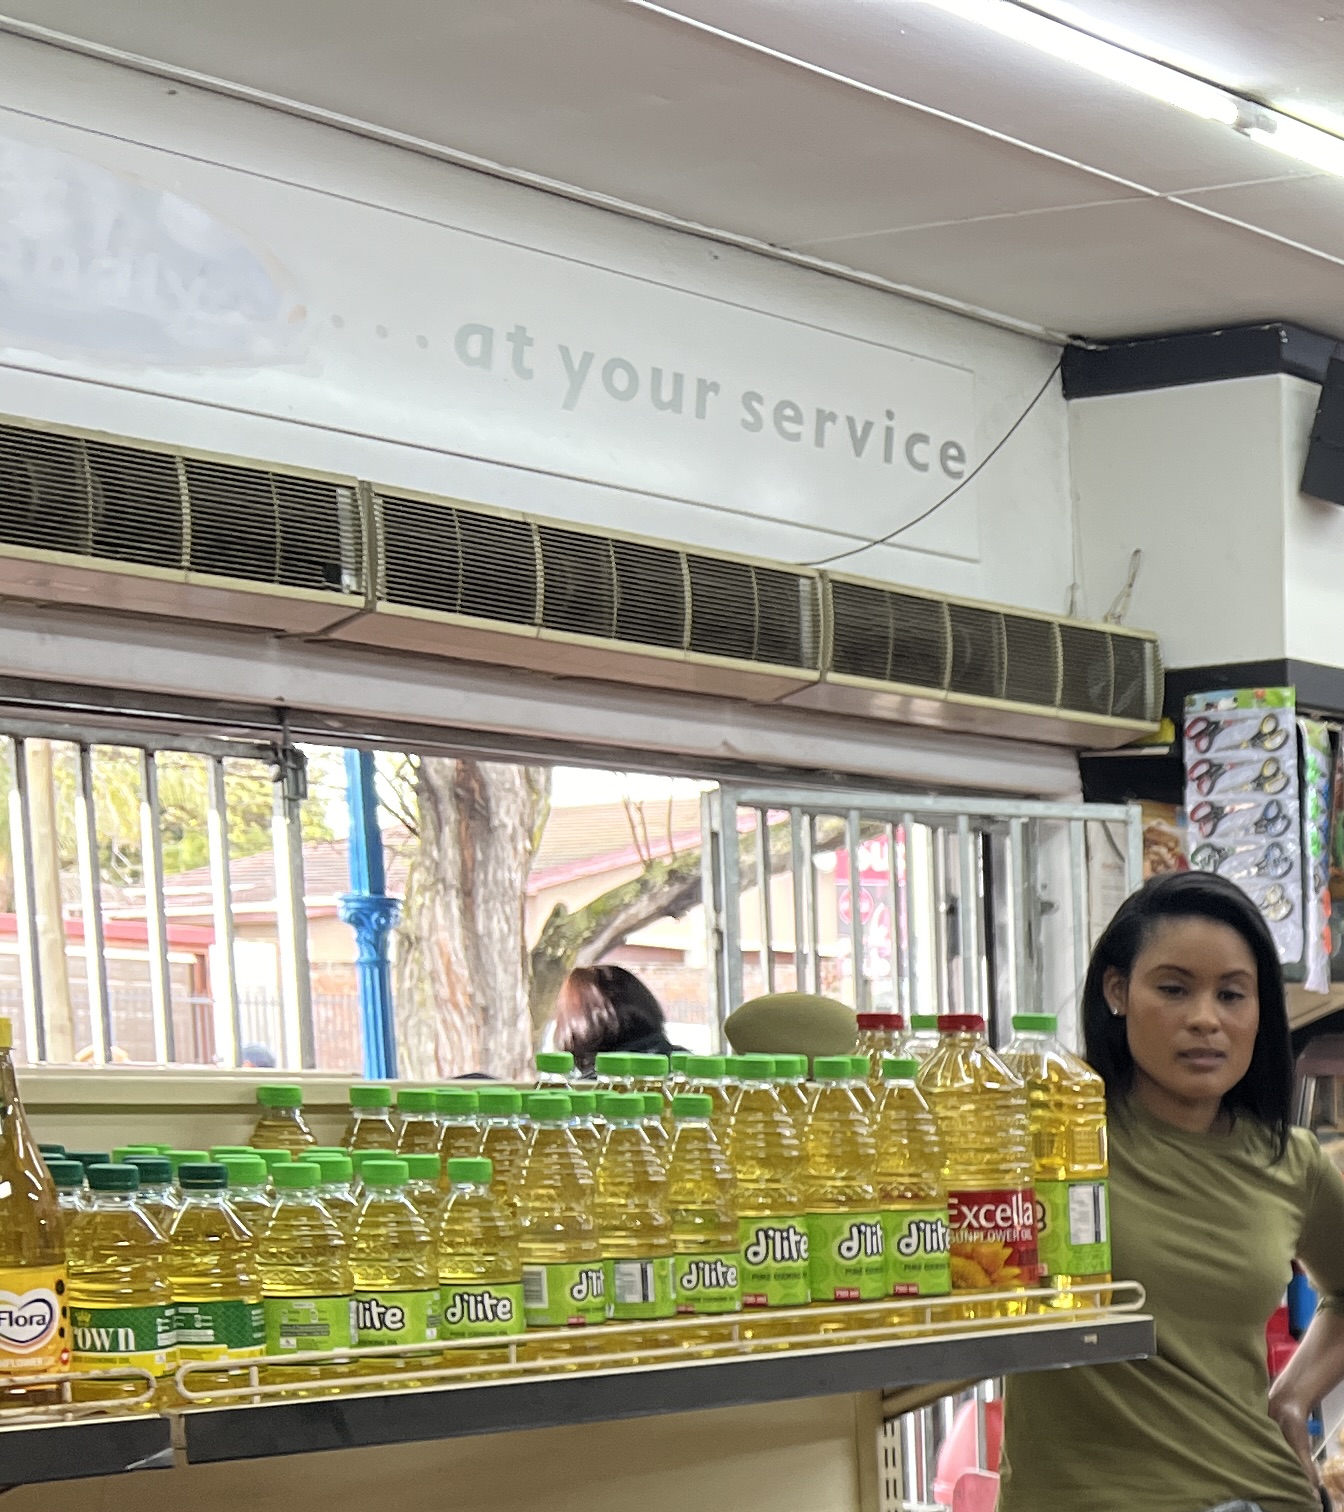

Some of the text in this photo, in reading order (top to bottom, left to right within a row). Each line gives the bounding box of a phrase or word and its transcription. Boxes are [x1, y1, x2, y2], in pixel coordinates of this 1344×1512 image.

[453, 320, 535, 380] at
[558, 343, 721, 420] your
[739, 388, 968, 480] service
[947, 1192, 1034, 1230] Excella
[838, 1222, 883, 1261] d'lit
[897, 1219, 950, 1257] d'lit
[680, 1258, 738, 1290] d'lite
[356, 1299, 405, 1331] lite
[446, 1291, 513, 1324] d'lite
